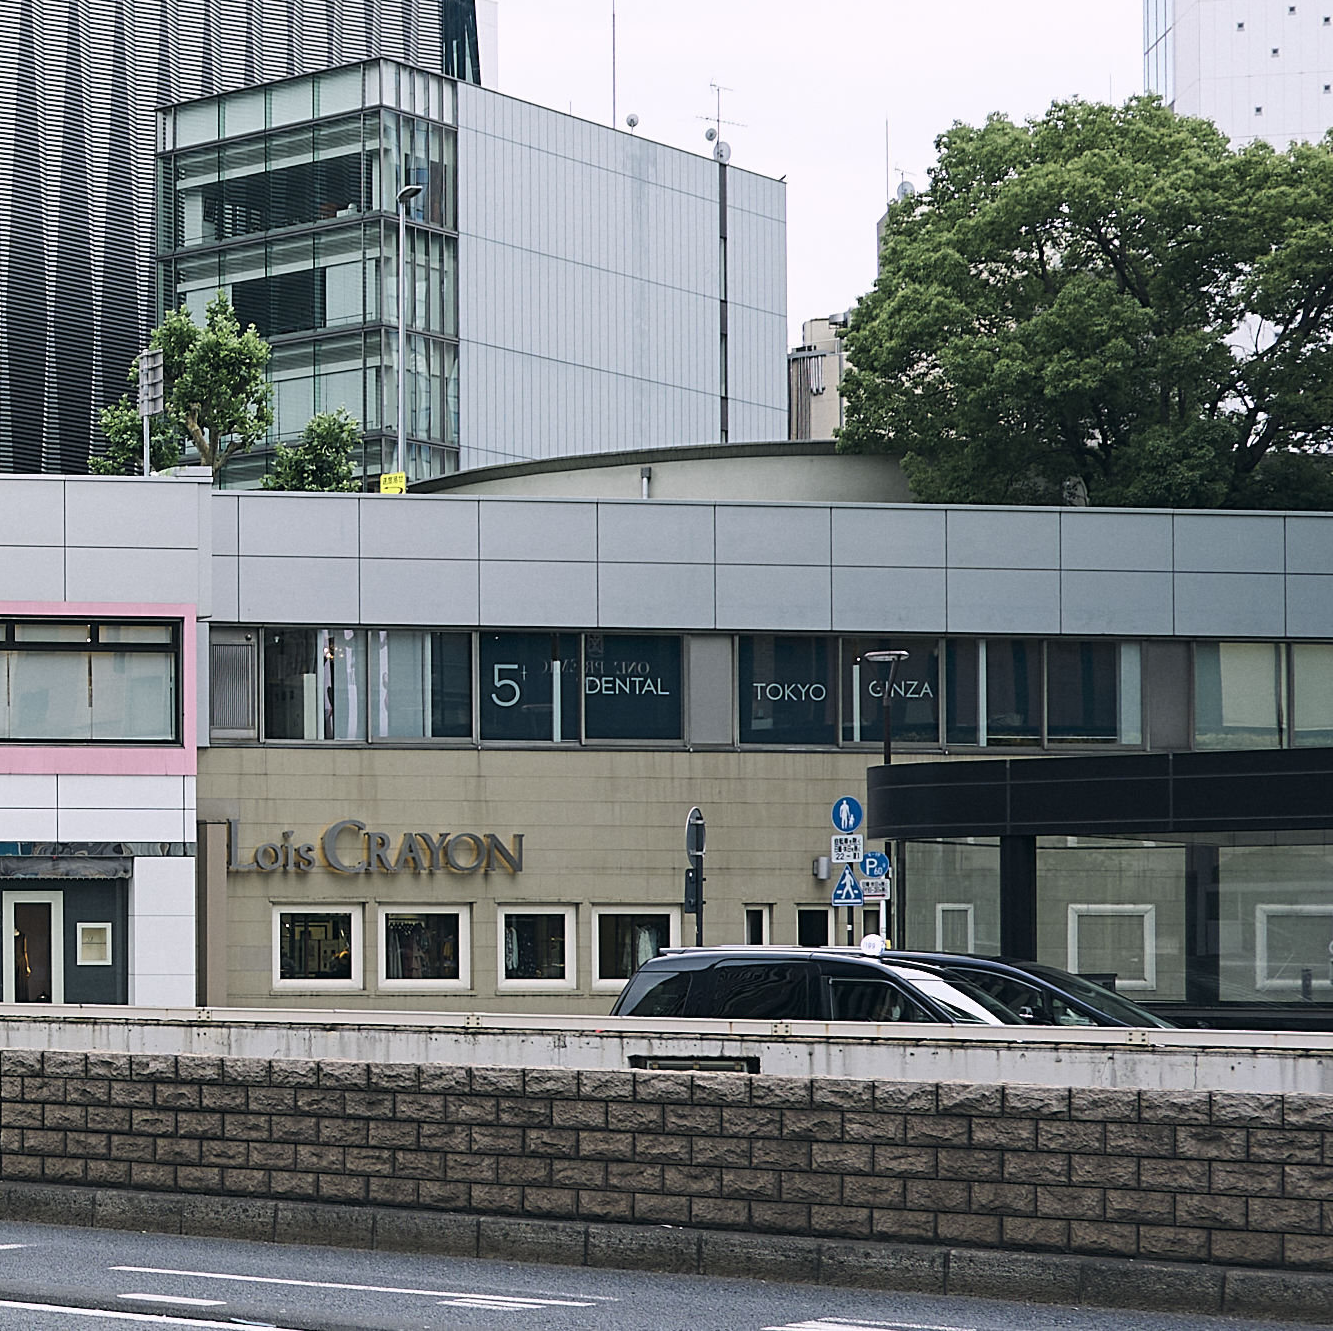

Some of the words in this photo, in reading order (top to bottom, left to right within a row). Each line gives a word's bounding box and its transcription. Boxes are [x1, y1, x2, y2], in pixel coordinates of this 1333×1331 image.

[585, 677, 670, 696] DENTAL
[752, 682, 827, 701] TOKYO
[226, 818, 317, 871] Lois
[321, 819, 525, 873] CRAYON
[865, 858, 878, 876] P
